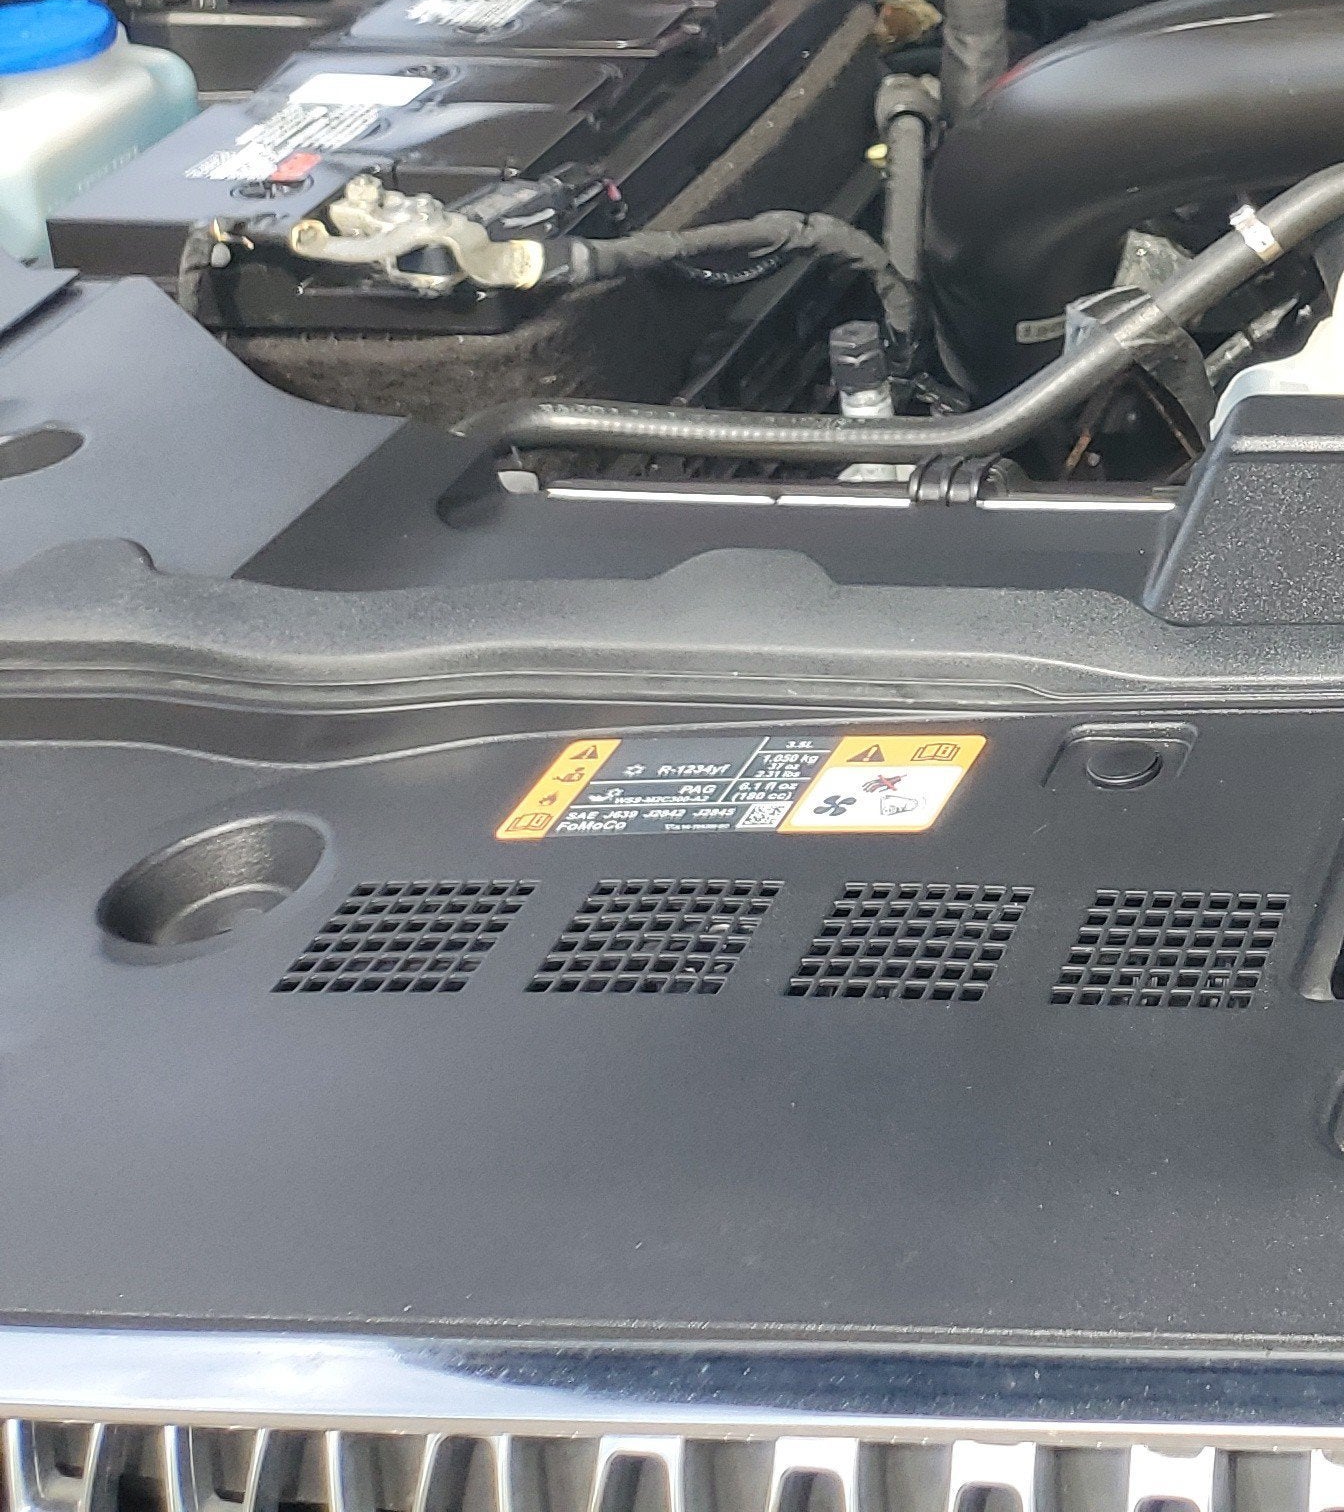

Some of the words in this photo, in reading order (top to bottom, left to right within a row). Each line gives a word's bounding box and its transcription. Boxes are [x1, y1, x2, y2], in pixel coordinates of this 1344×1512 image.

[762, 753, 799, 763] 1.050
[800, 754, 819, 765] kg
[657, 763, 730, 778] R-1234yf
[679, 784, 717, 795] PAG
[769, 791, 792, 801] cc)
[566, 811, 599, 820] SAE
[556, 820, 626, 832] FoMoCo
